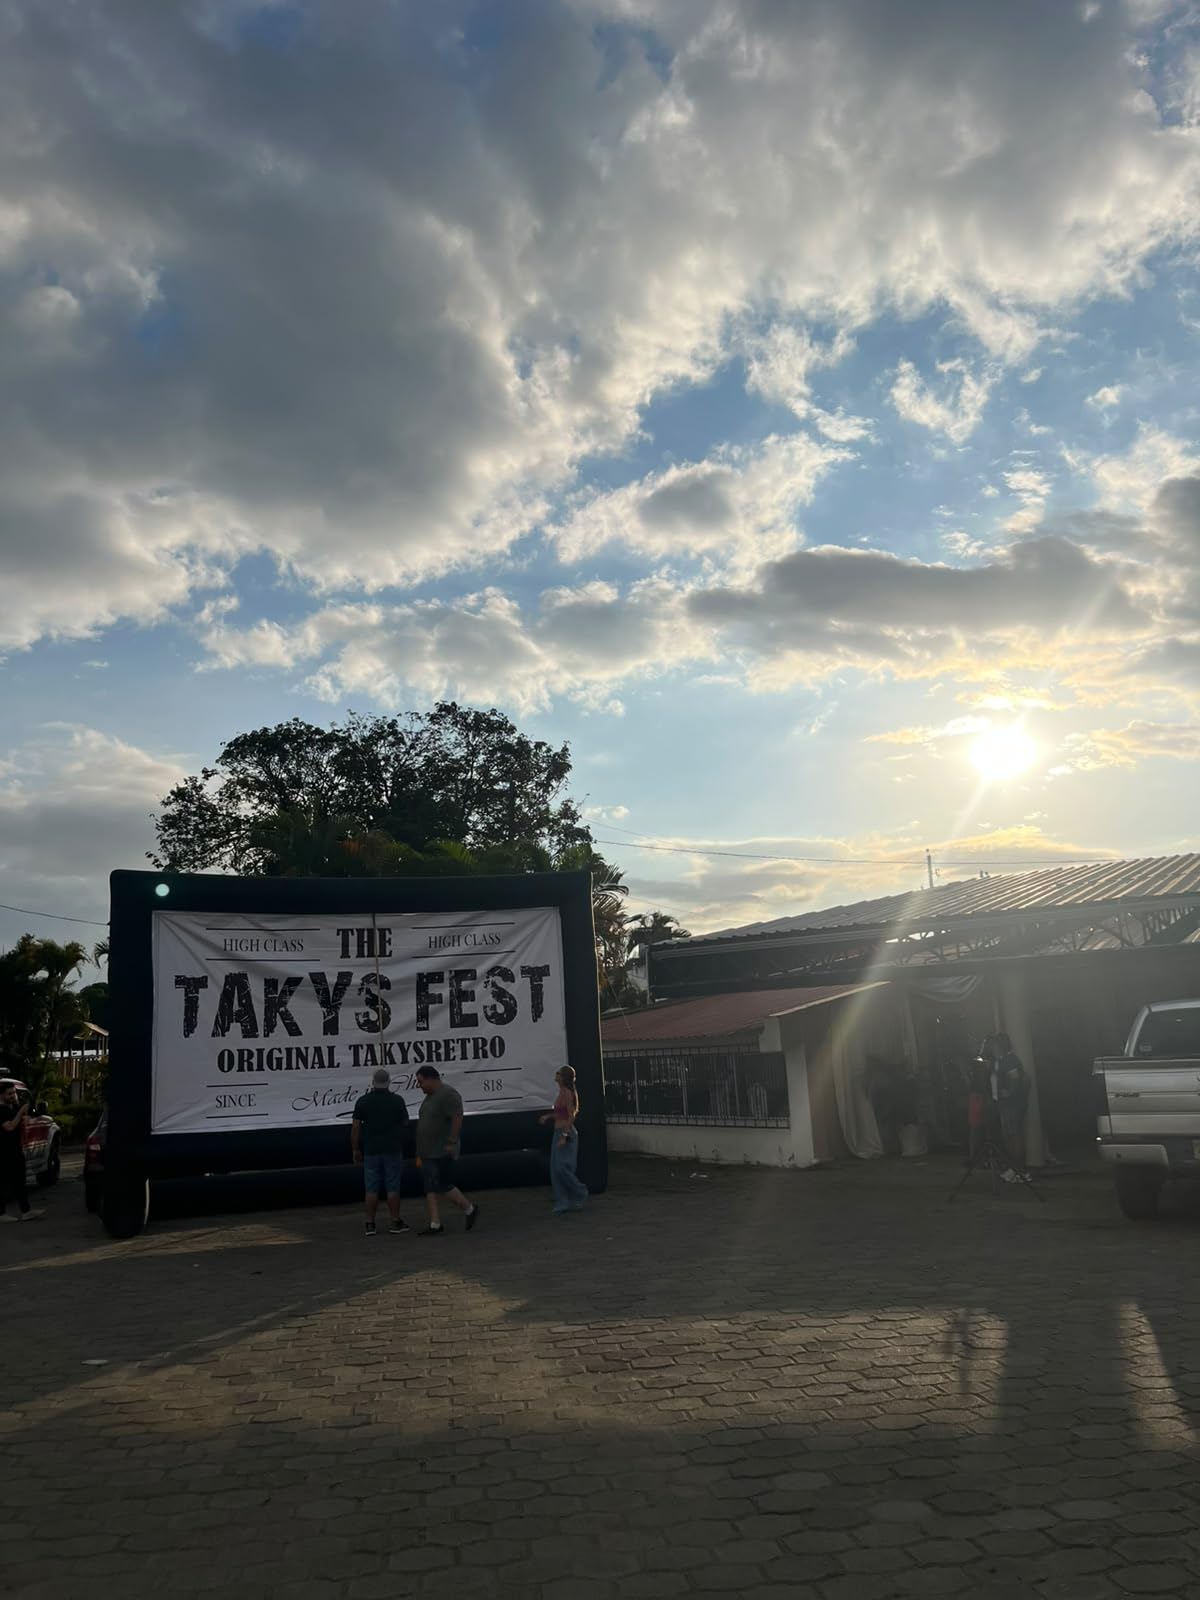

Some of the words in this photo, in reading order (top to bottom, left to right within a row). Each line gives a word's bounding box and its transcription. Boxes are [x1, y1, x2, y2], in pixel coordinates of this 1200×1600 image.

[223, 939, 262, 952] HIGH
[264, 938, 304, 952] CLASS
[336, 928, 392, 959] THE
[428, 936, 461, 948] HIGH
[464, 933, 501, 947] CLASS
[174, 971, 392, 1039] TAKYS
[415, 965, 551, 1032] FEST
[217, 1045, 341, 1073] ORIGINAL
[348, 1035, 506, 1067] TAKYSRETRO
[483, 1079, 503, 1092] 818
[215, 1093, 257, 1109] SINCE
[291, 1085, 358, 1111] Made
